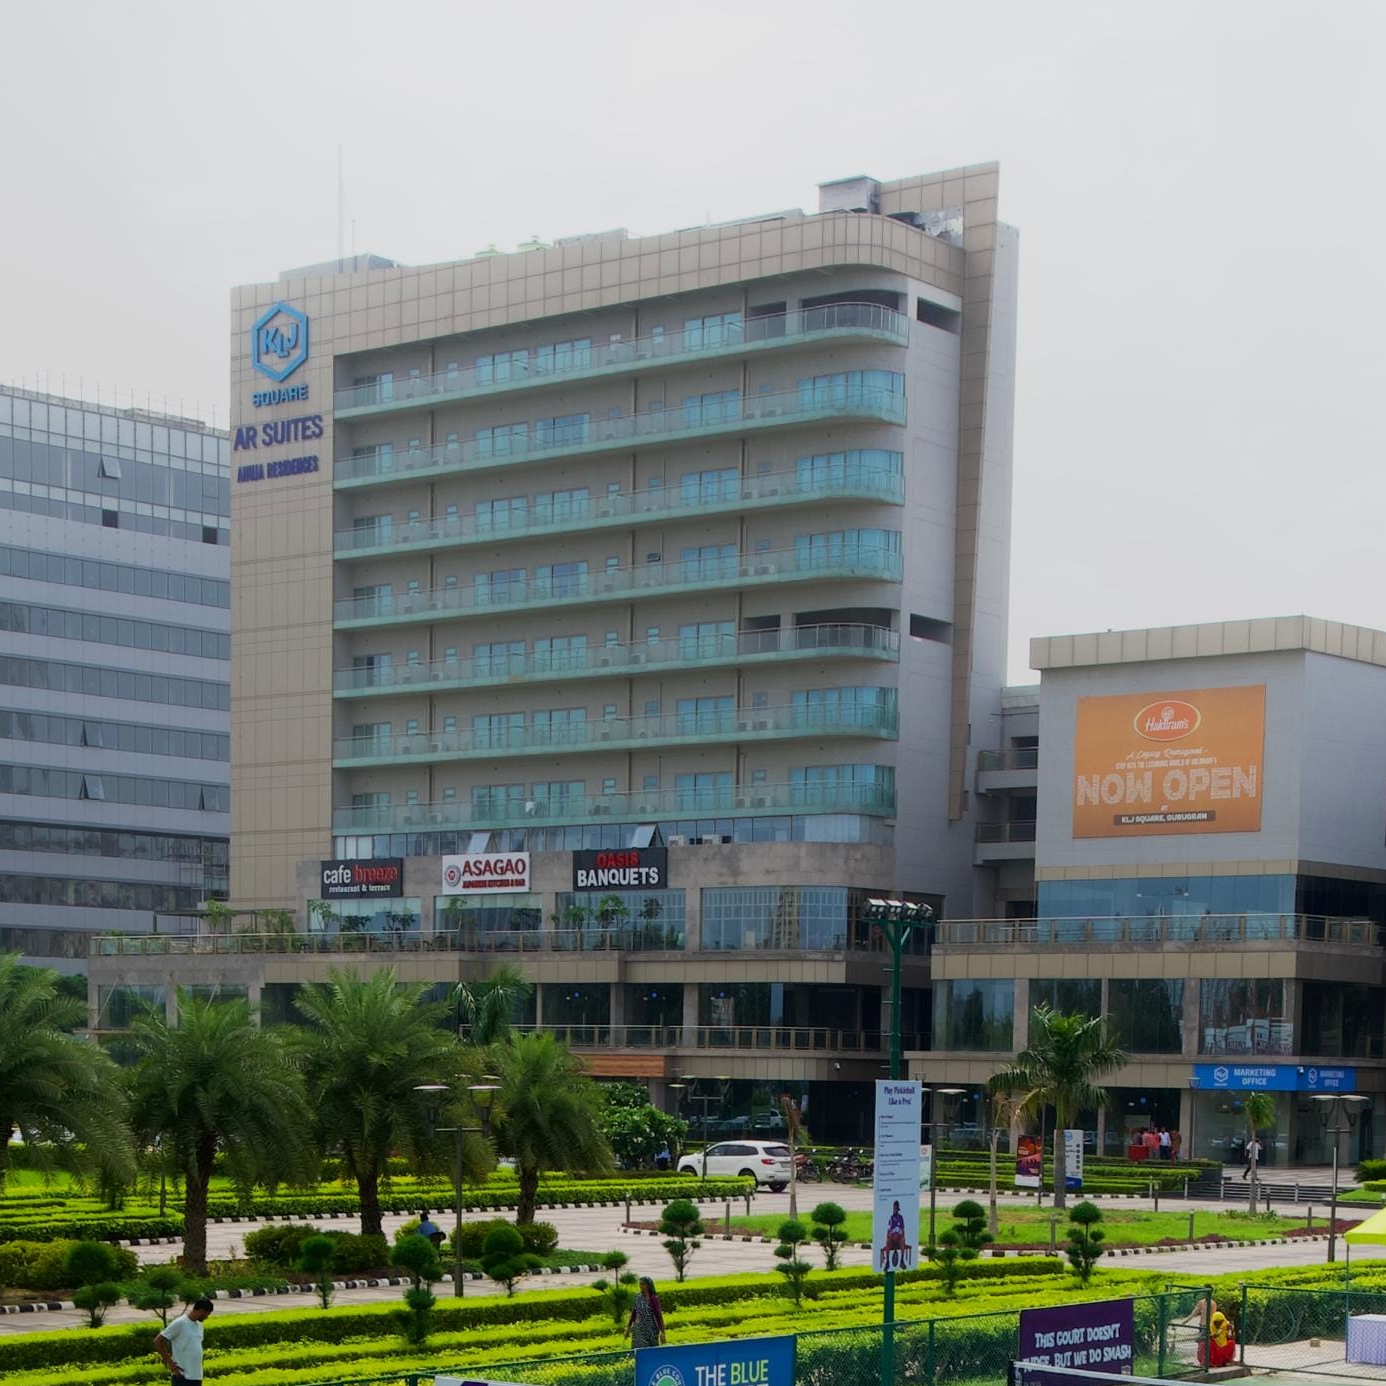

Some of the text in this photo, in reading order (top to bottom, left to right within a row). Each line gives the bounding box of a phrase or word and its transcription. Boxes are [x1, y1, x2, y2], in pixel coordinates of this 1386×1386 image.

[260, 323, 298, 358] KLJ
[253, 384, 308, 408] SQUARE
[234, 415, 324, 451] AR SUITES
[267, 455, 319, 479] RESIDENCES
[1145, 717, 1189, 732] Haldiram's
[1077, 765, 1256, 806] NOW OPEN
[462, 858, 526, 877] ASAGAO
[596, 851, 638, 868] OASIS
[324, 864, 397, 883] cafe breeze
[577, 867, 659, 887] BANQUETS
[329, 884, 360, 893] restaurant
[1234, 1068, 1276, 1077] MARKETING
[1242, 1077, 1267, 1085] OFFICE
[1035, 1323, 1120, 1348] THIS COURT DOESN'T
[1054, 1352, 1072, 1367] BUT
[1074, 1351, 1087, 1366] WE
[1089, 1348, 1101, 1363] DO
[1103, 1344, 1131, 1362] SMASH
[731, 1360, 769, 1385] BLUE
